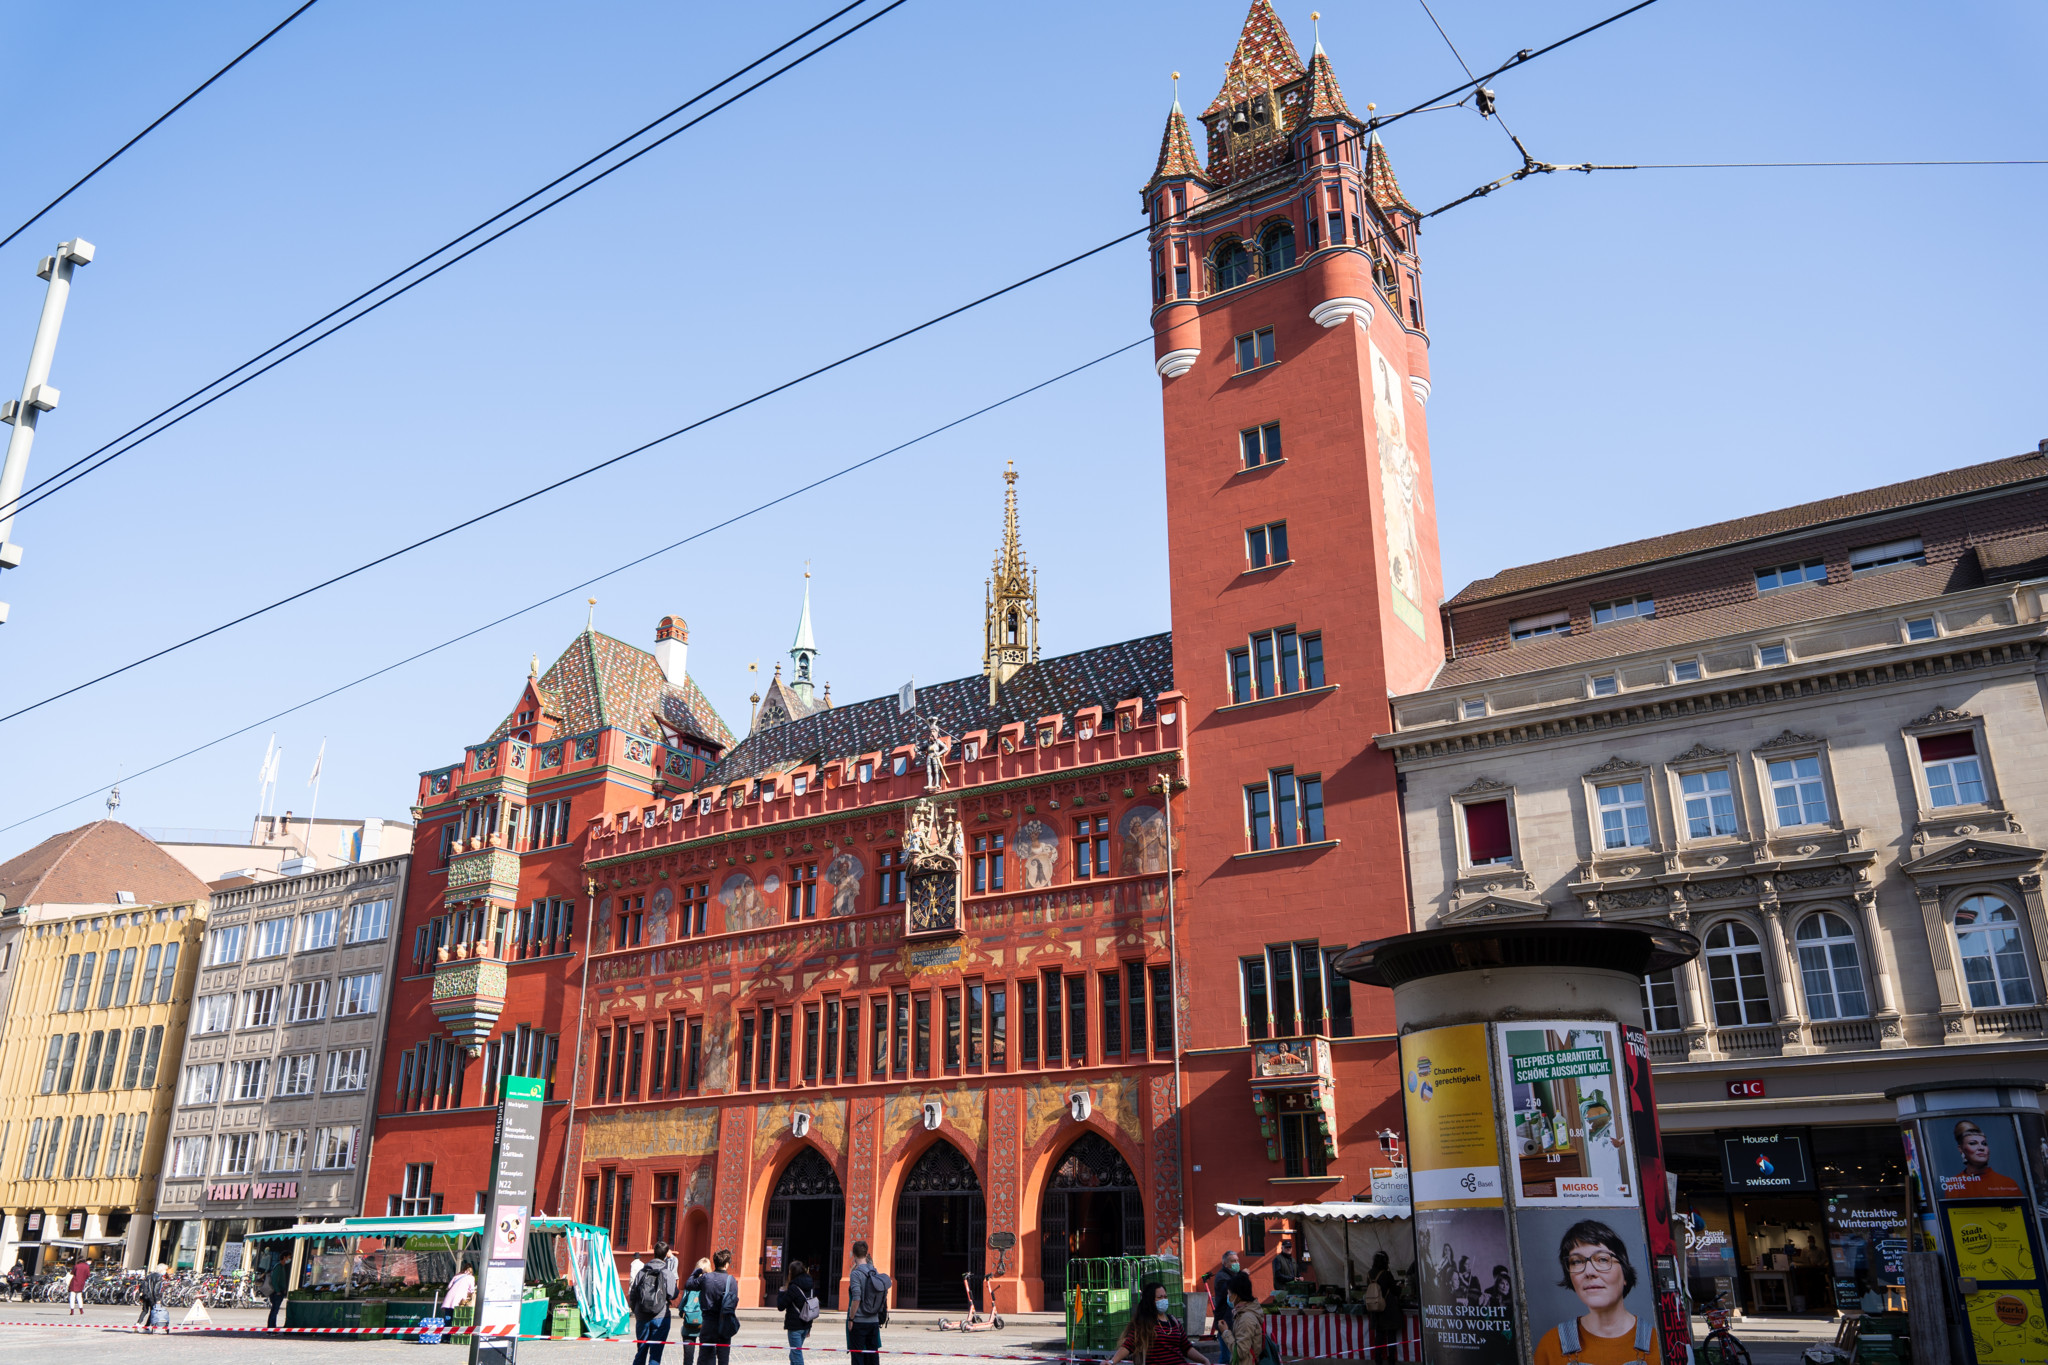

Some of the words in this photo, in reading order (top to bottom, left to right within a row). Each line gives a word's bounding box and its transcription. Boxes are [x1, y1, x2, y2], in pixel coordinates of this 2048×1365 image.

[1515, 1053, 1555, 1069] TIEFPREIS
[1556, 1049, 1601, 1064] GARANTIERT.
[1433, 1066, 1465, 1076] Chancen-
[1516, 1067, 1550, 1082] SCHÖNE
[1551, 1063, 1588, 1078] AUSSICHT
[1588, 1061, 1611, 1074] NICHT.
[1434, 1074, 1481, 1088] gerechtigkeit
[1730, 1082, 1761, 1095] CIC
[495, 1101, 504, 1144] Marktplatz
[505, 1118, 513, 1126] 14
[1742, 1134, 1769, 1144] House
[1769, 1133, 1779, 1143] of
[502, 1143, 510, 1151] 16
[1546, 1153, 1561, 1163] 1.10
[500, 1161, 508, 1169] 17
[1394, 1172, 1408, 1180] Seit
[1746, 1176, 1791, 1186] swisscom
[1939, 1174, 1981, 1183] Ramstein
[499, 1180, 512, 1189] N22
[1562, 1183, 1599, 1192] MIGROS
[1941, 1182, 1966, 1192] Optik
[207, 1183, 250, 1201] TALLY
[1374, 1194, 1395, 1203] Obst,
[1851, 1208, 1898, 1218] Attraktive
[1961, 1226, 1983, 1238] Stadt
[1962, 1233, 1988, 1245] Markt
[1455, 1305, 1507, 1317] SPRICHT
[1997, 1305, 2024, 1315] Markt
[1425, 1317, 1445, 1330] DORT,
[1446, 1318, 1463, 1330] WO
[1465, 1319, 1511, 1331] WORTE
[1437, 1331, 1487, 1345] FEHLEN.»
